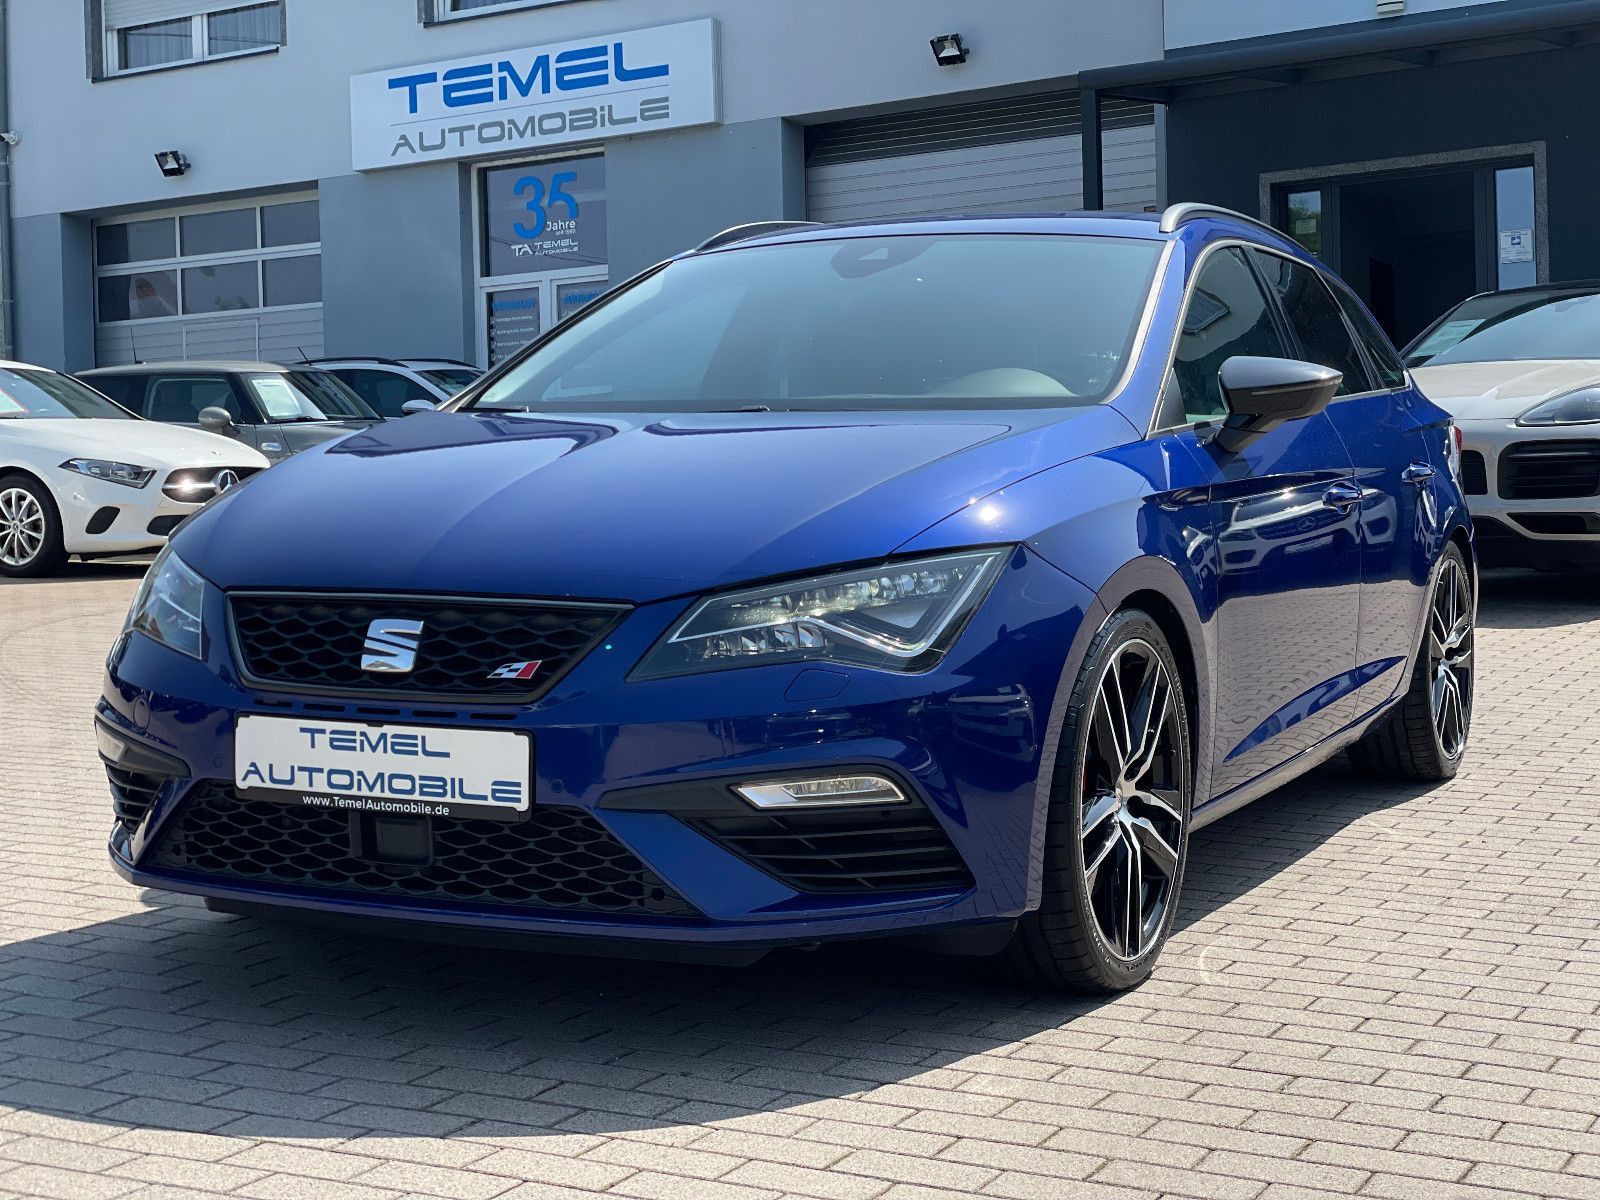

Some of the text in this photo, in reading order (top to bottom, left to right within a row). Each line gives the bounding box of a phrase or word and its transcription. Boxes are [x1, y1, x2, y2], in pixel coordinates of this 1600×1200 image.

[388, 42, 669, 114] TEMEL
[512, 171, 579, 240] 35
[546, 219, 576, 231] Jahre
[511, 243, 533, 256] TA
[534, 238, 579, 249] TEMEL
[299, 727, 451, 758] TEMEL
[242, 762, 522, 803] AUTOMOBILE
[302, 795, 450, 816] www.TemelAutomobile.de
